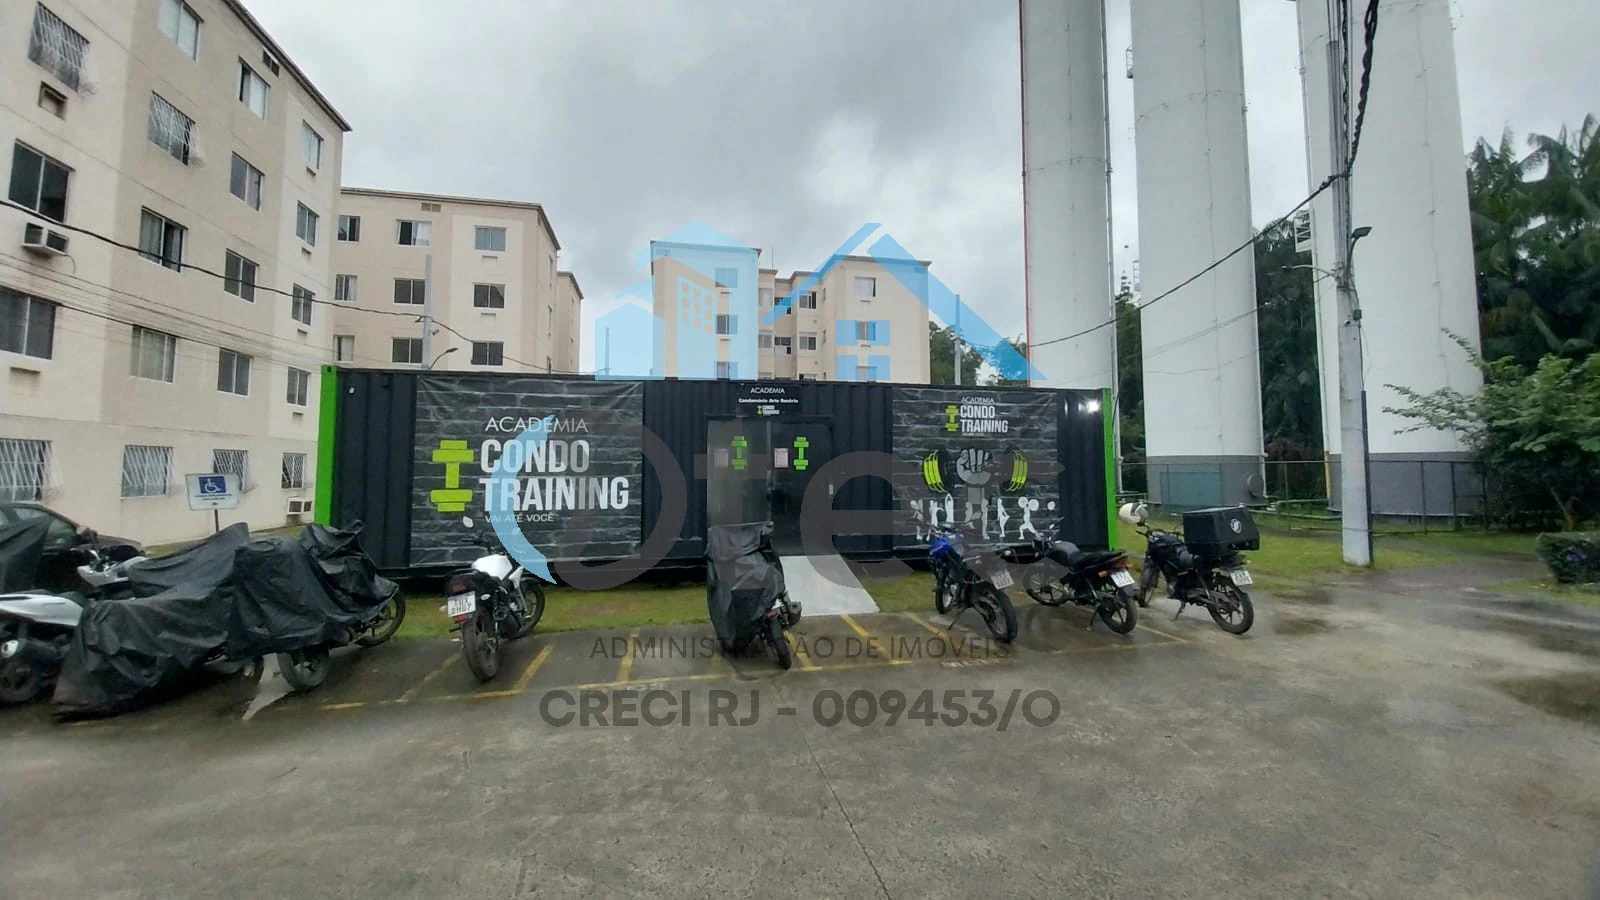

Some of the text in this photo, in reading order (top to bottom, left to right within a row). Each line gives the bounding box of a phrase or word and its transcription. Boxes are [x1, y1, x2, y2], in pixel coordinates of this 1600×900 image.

[960, 405, 996, 418] CONDO
[484, 416, 589, 433] ACADEMIA
[960, 419, 1009, 433] TRAINING
[480, 439, 590, 473] CONDO
[479, 476, 629, 512] TRAINING
[484, 514, 501, 523] VAI
